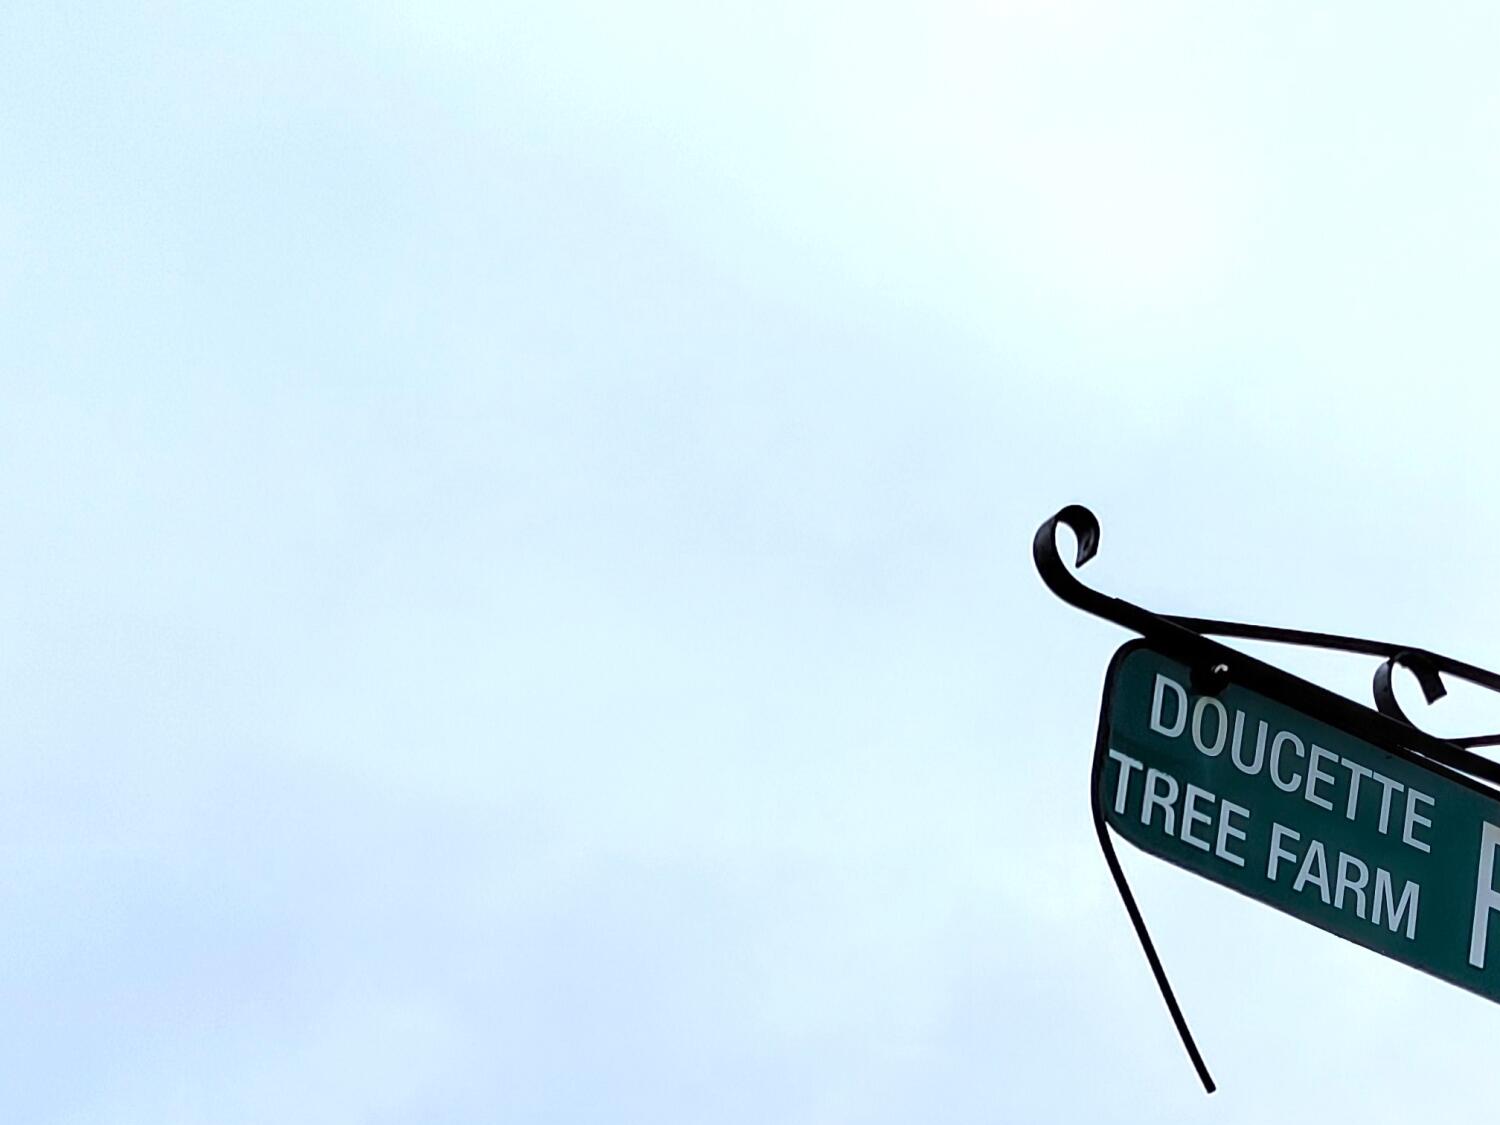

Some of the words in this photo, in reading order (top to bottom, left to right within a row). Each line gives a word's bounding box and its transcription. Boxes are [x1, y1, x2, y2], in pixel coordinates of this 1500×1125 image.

[1108, 749, 1250, 867] TREE
[1266, 822, 1420, 940] FARM
[1150, 673, 1435, 853] DOUCETTE
